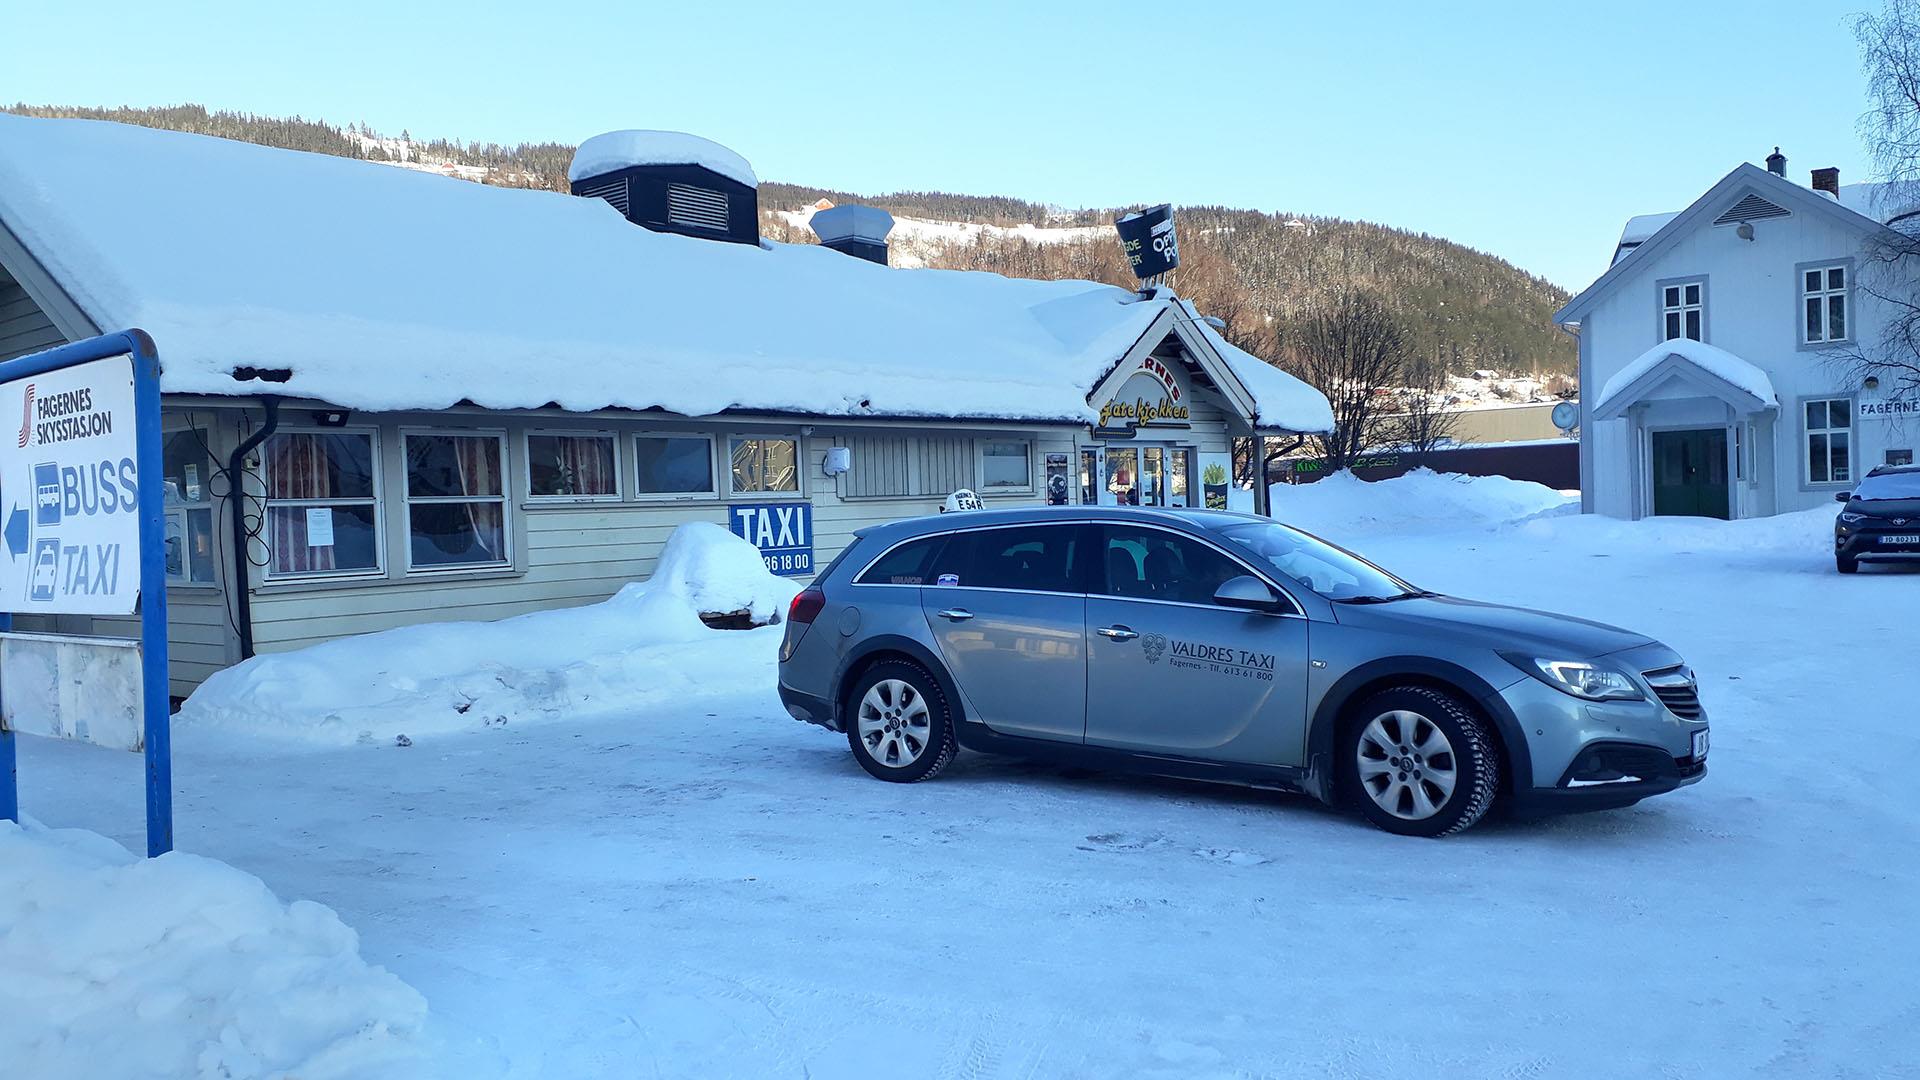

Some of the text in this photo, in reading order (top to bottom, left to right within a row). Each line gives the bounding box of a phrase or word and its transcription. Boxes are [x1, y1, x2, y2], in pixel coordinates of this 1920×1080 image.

[1138, 357, 1181, 402] RNES
[37, 388, 92, 420] FAGERNES
[37, 411, 112, 446] SKYSSTASJON
[61, 456, 138, 516] BUSS
[737, 507, 804, 548] TAXI
[62, 543, 120, 596] TAXI
[780, 555, 792, 570] 18
[794, 554, 808, 569] 00
[1169, 658, 1201, 671] Fagernes
[1223, 666, 1240, 676] 613
[1243, 668, 1253, 678] 61
[1256, 671, 1273, 682] 800
[1171, 640, 1275, 670] VALDRES TAXI
